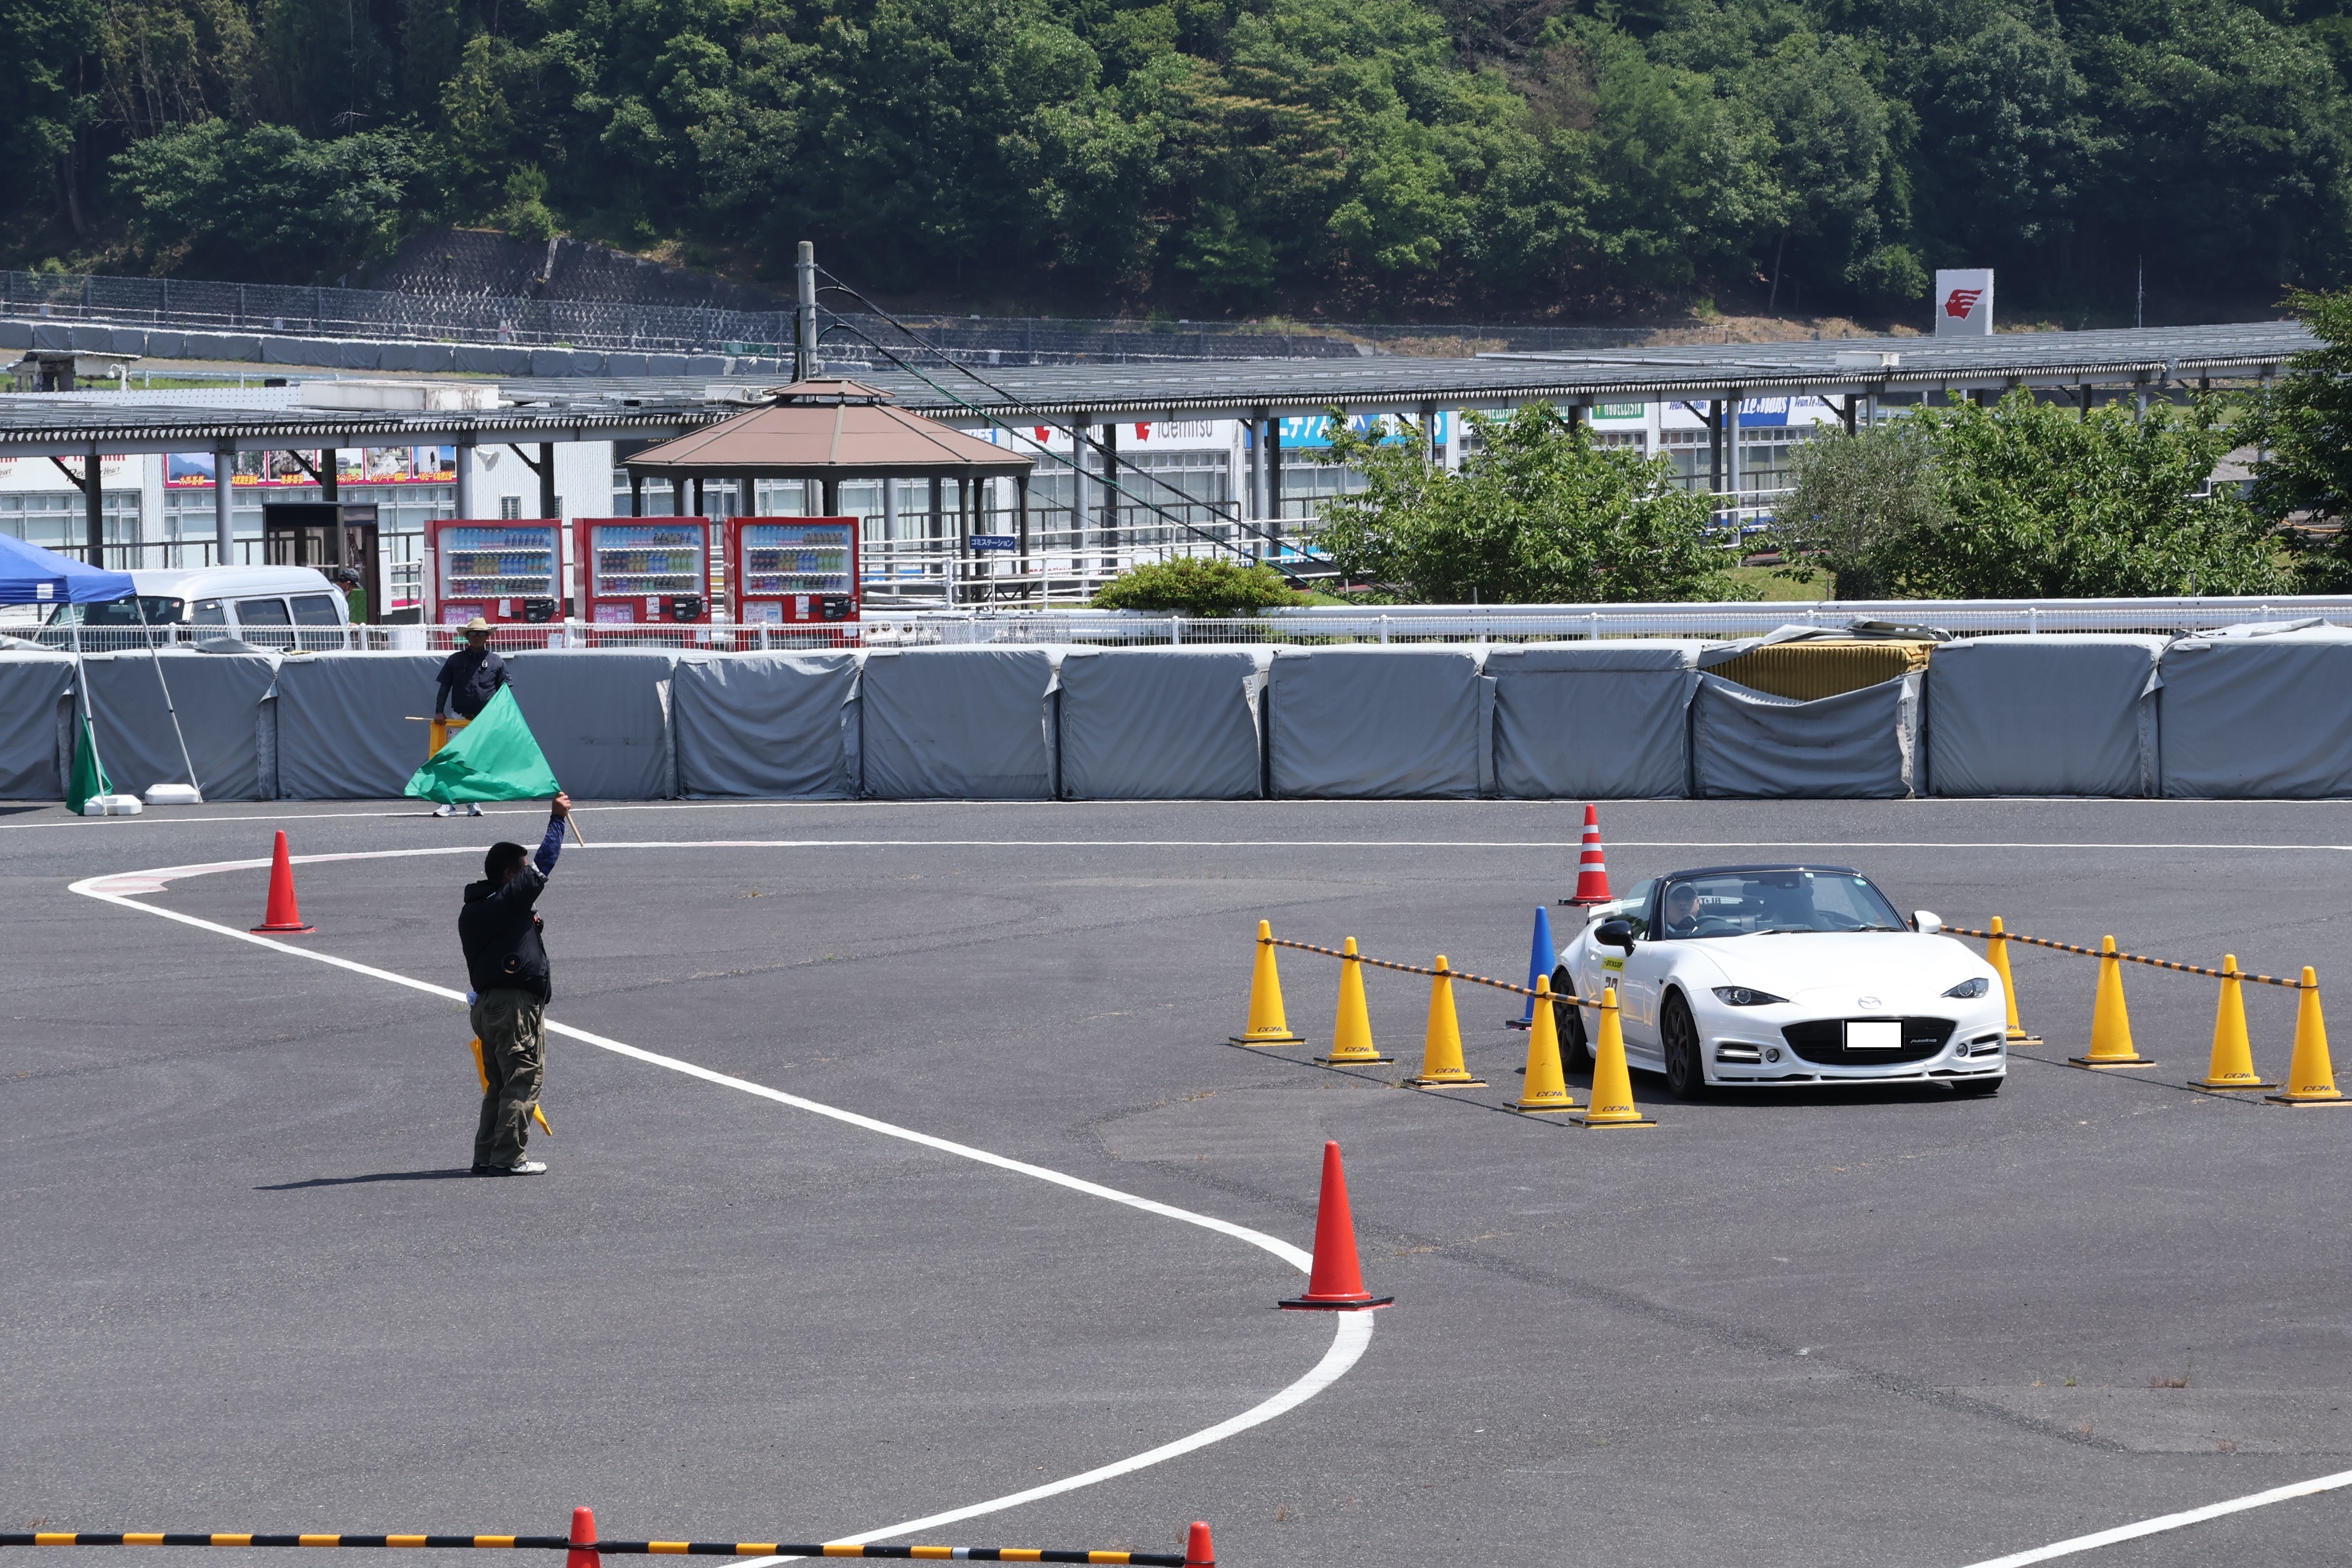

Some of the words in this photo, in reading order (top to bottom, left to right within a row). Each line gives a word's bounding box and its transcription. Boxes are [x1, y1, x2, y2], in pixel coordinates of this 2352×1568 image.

[971, 538, 1013, 547] ゴミステーション
[1606, 959, 1623, 968] DUNLOP
